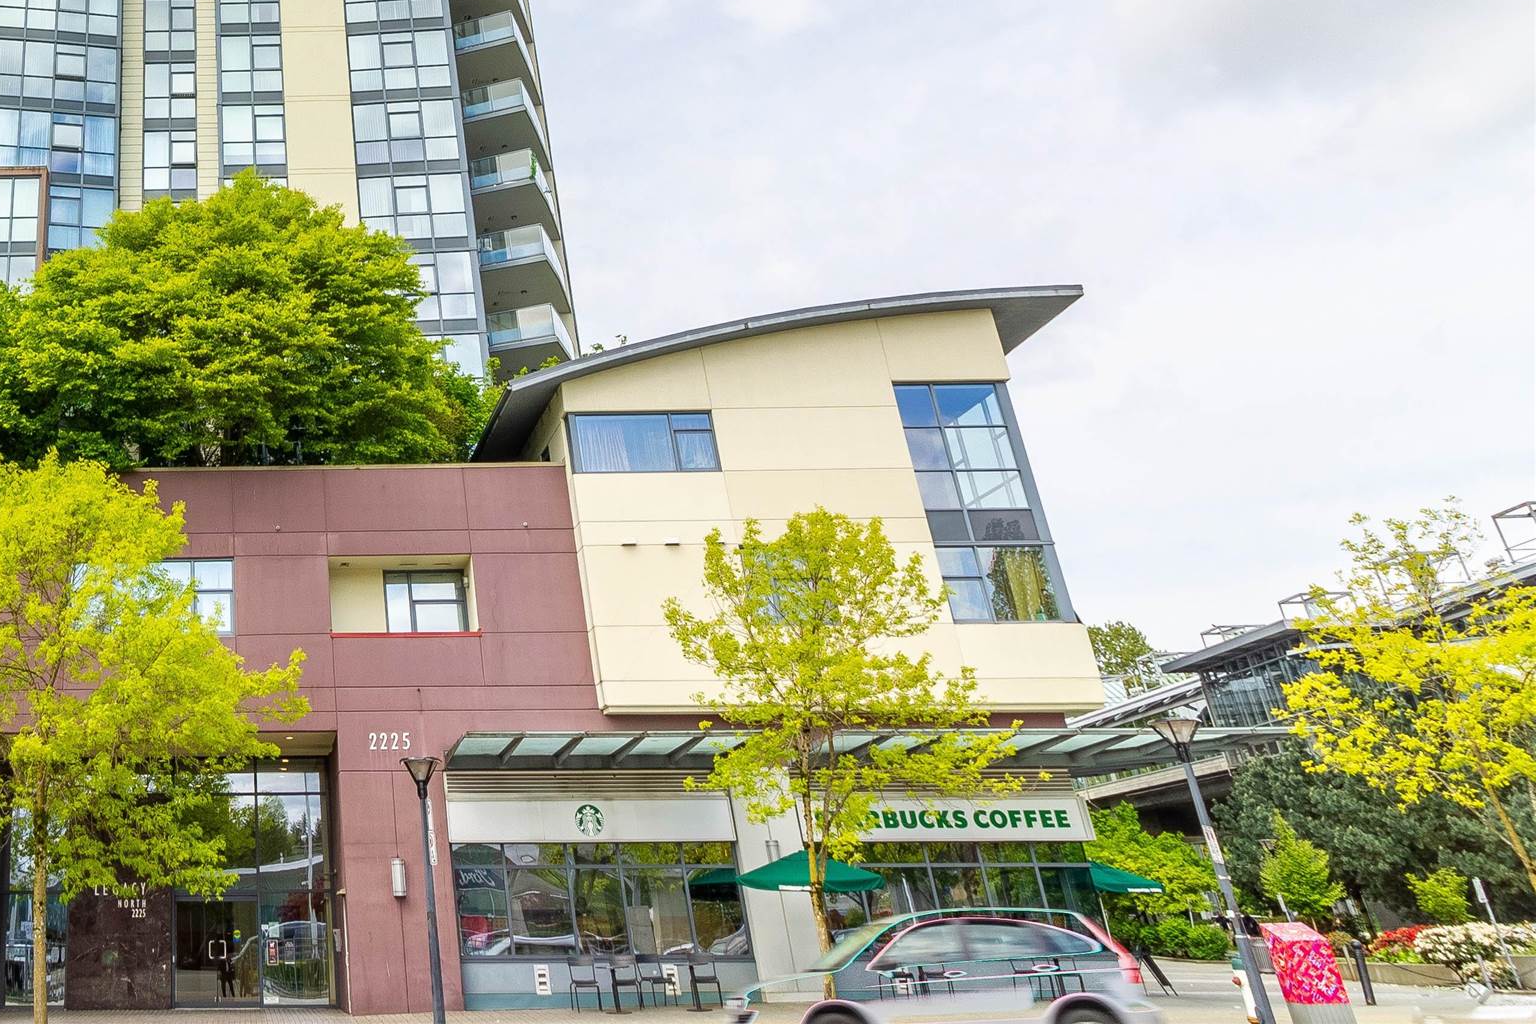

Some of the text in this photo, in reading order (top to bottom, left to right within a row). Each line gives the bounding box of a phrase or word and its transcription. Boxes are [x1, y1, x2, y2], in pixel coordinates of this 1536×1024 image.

[368, 732, 411, 751] 2225
[815, 809, 1072, 829] RBUCKS COFFEE
[117, 899, 147, 908] NORTH
[131, 908, 146, 918] 2225
